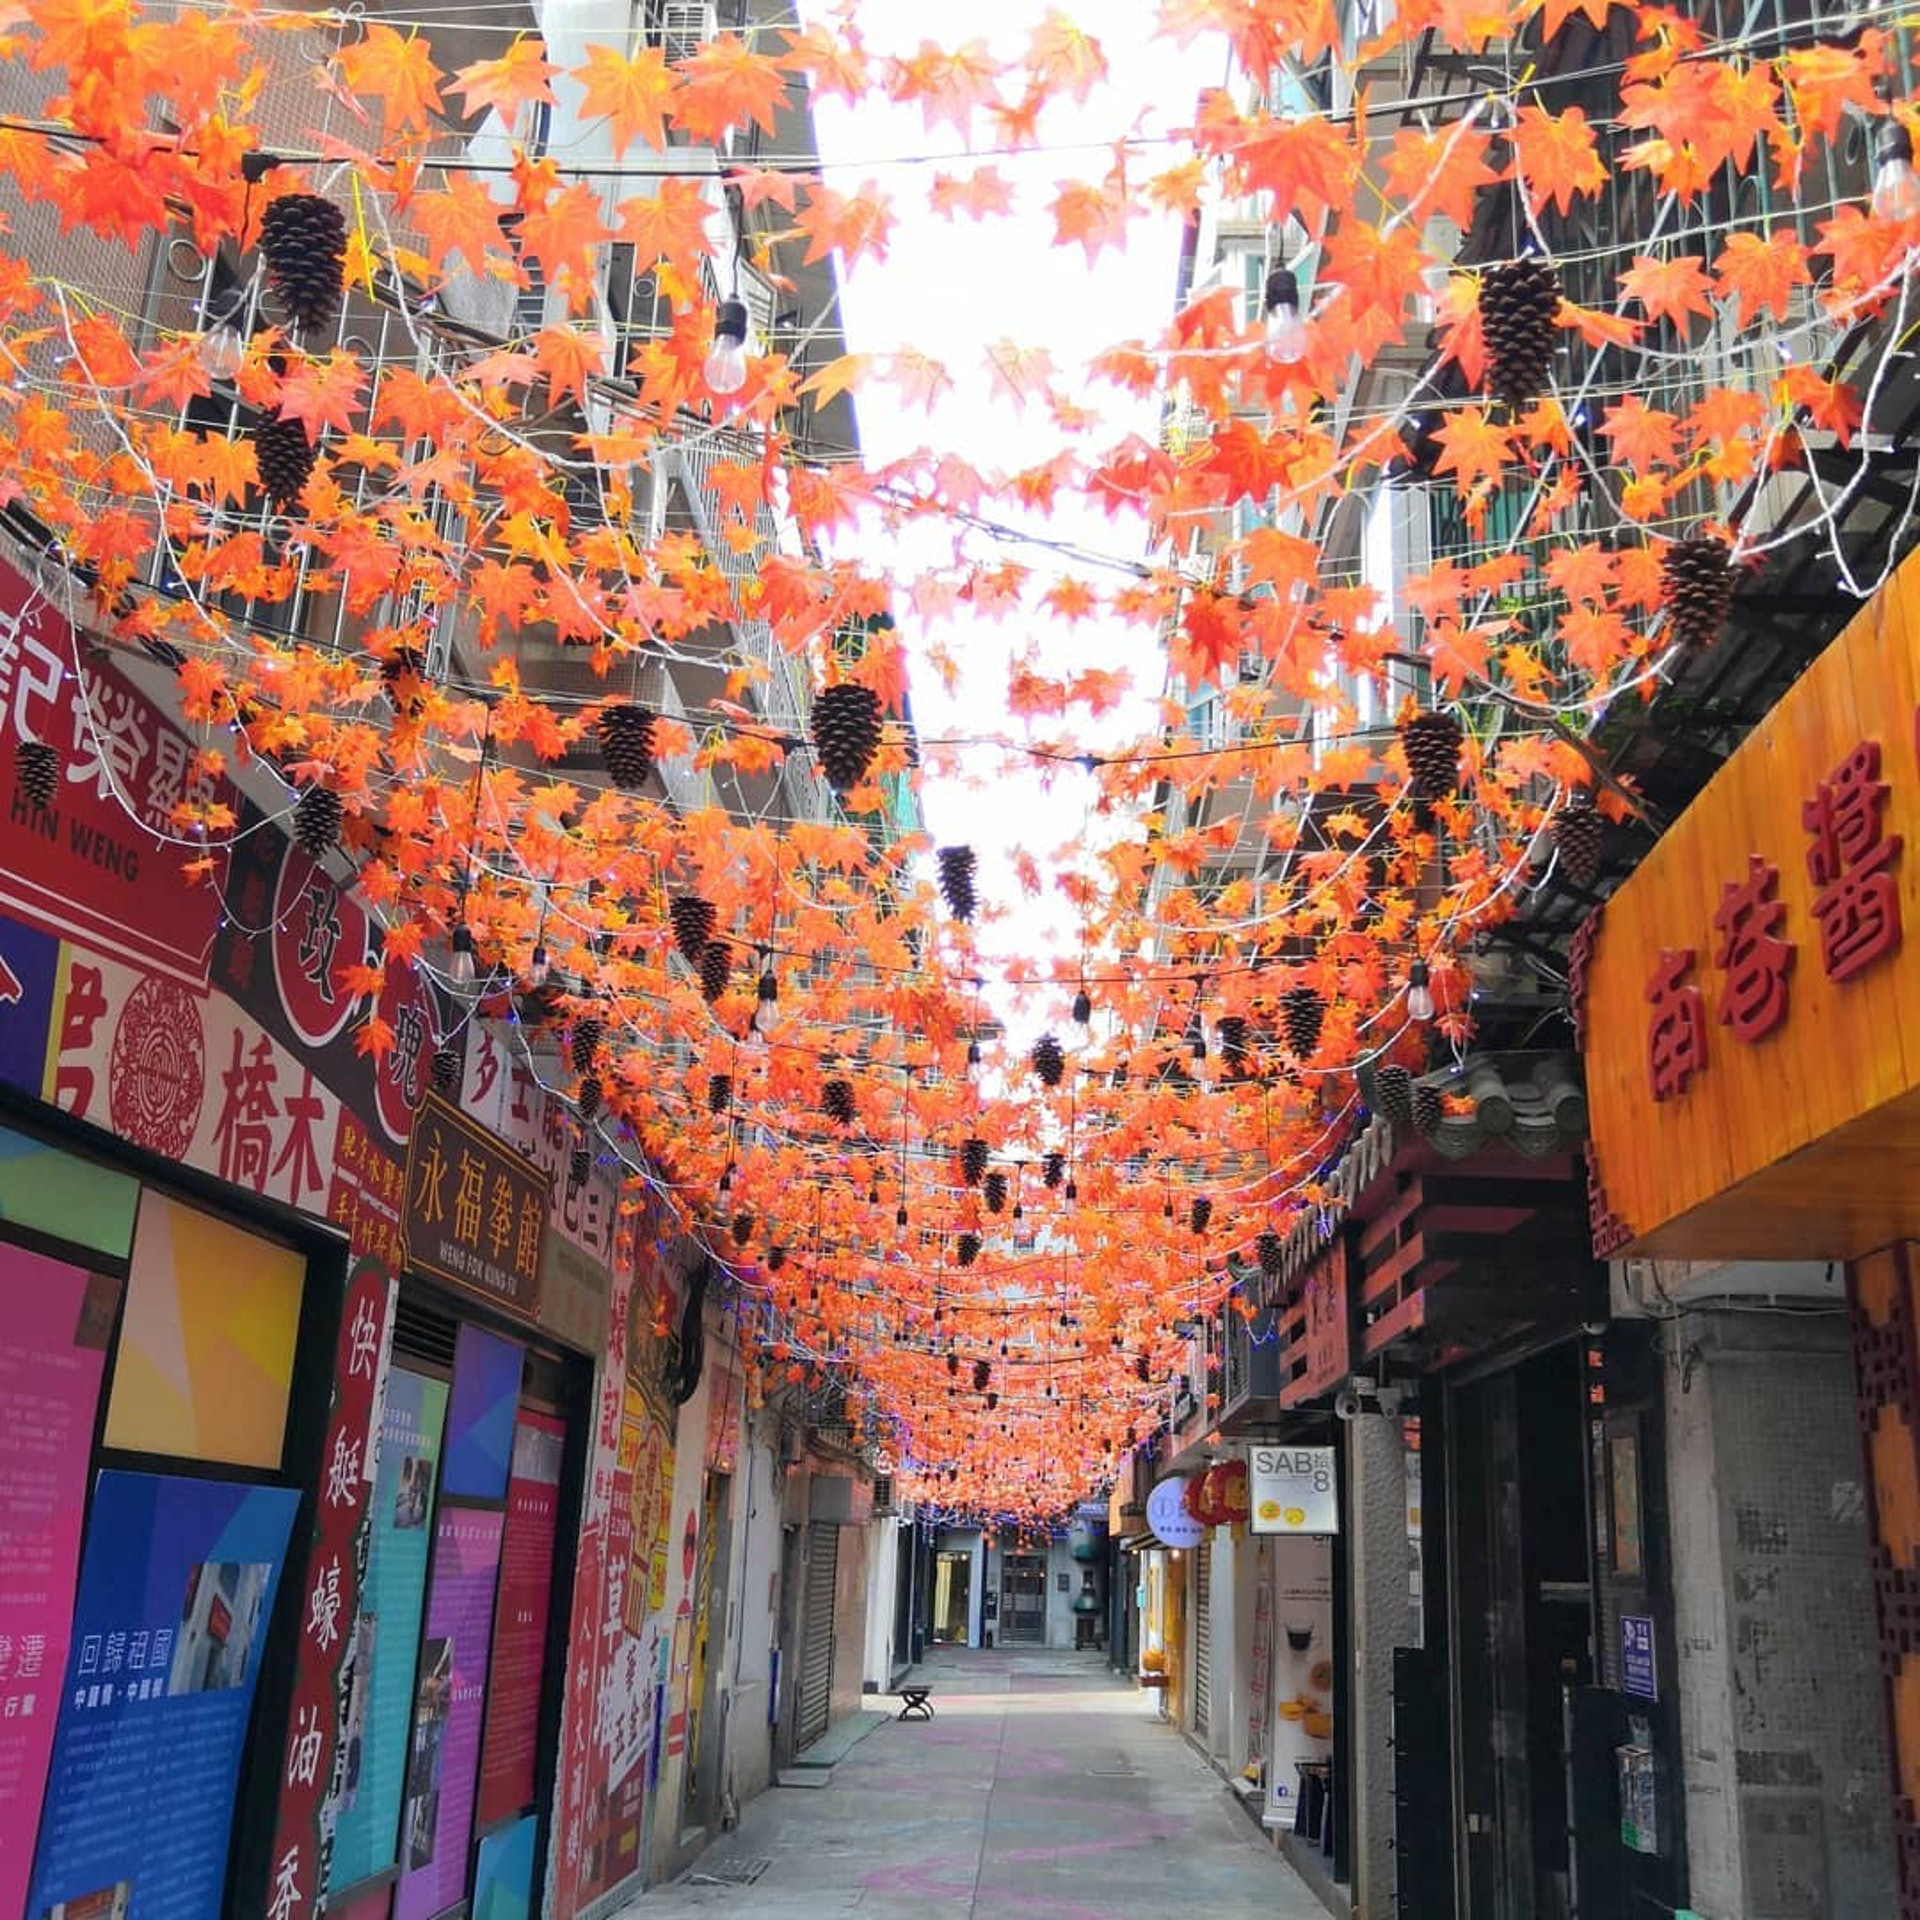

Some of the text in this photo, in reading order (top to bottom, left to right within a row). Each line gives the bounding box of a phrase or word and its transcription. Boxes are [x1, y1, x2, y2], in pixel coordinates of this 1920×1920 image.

[70, 816, 140, 883] WENG
[414, 1128, 543, 1281] 永福拳館
[1256, 1451, 1331, 1493] SAB 8
